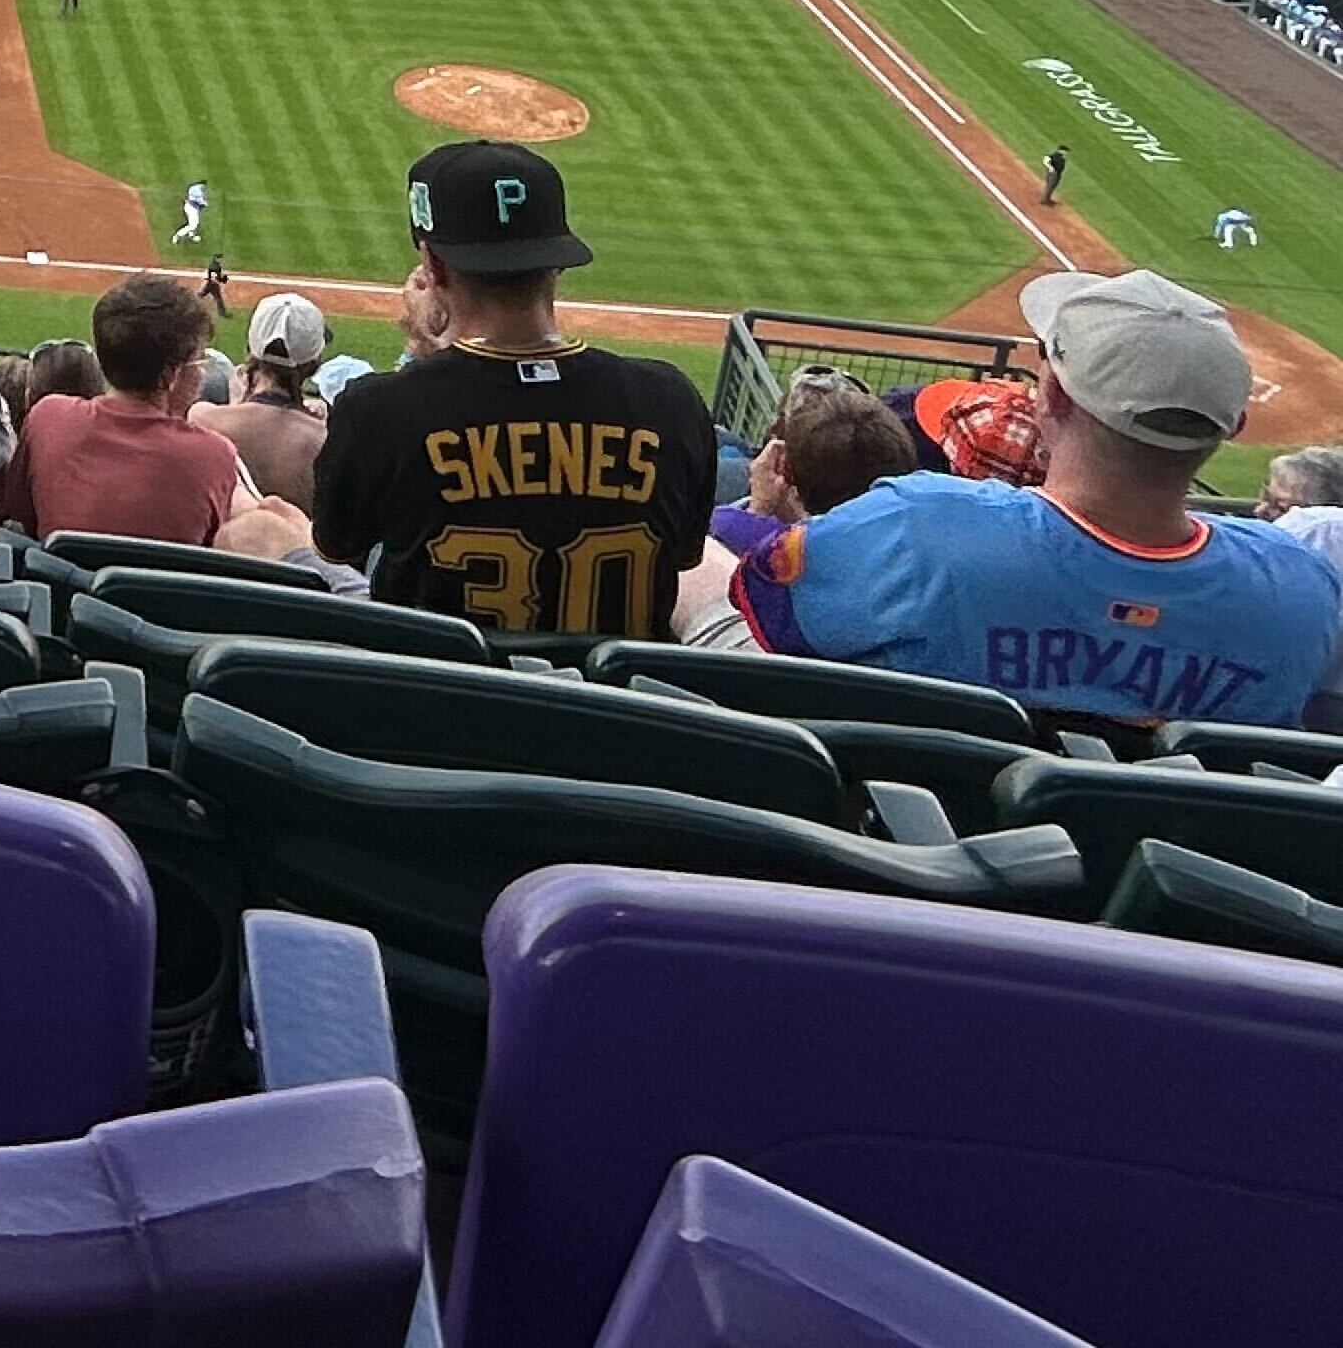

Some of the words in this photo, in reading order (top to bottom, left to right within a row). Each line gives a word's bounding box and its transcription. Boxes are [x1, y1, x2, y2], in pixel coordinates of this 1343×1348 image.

[494, 178, 528, 227] P
[425, 420, 661, 504] SKENES
[424, 521, 666, 634] 30
[986, 627, 1266, 719] BRYANT
